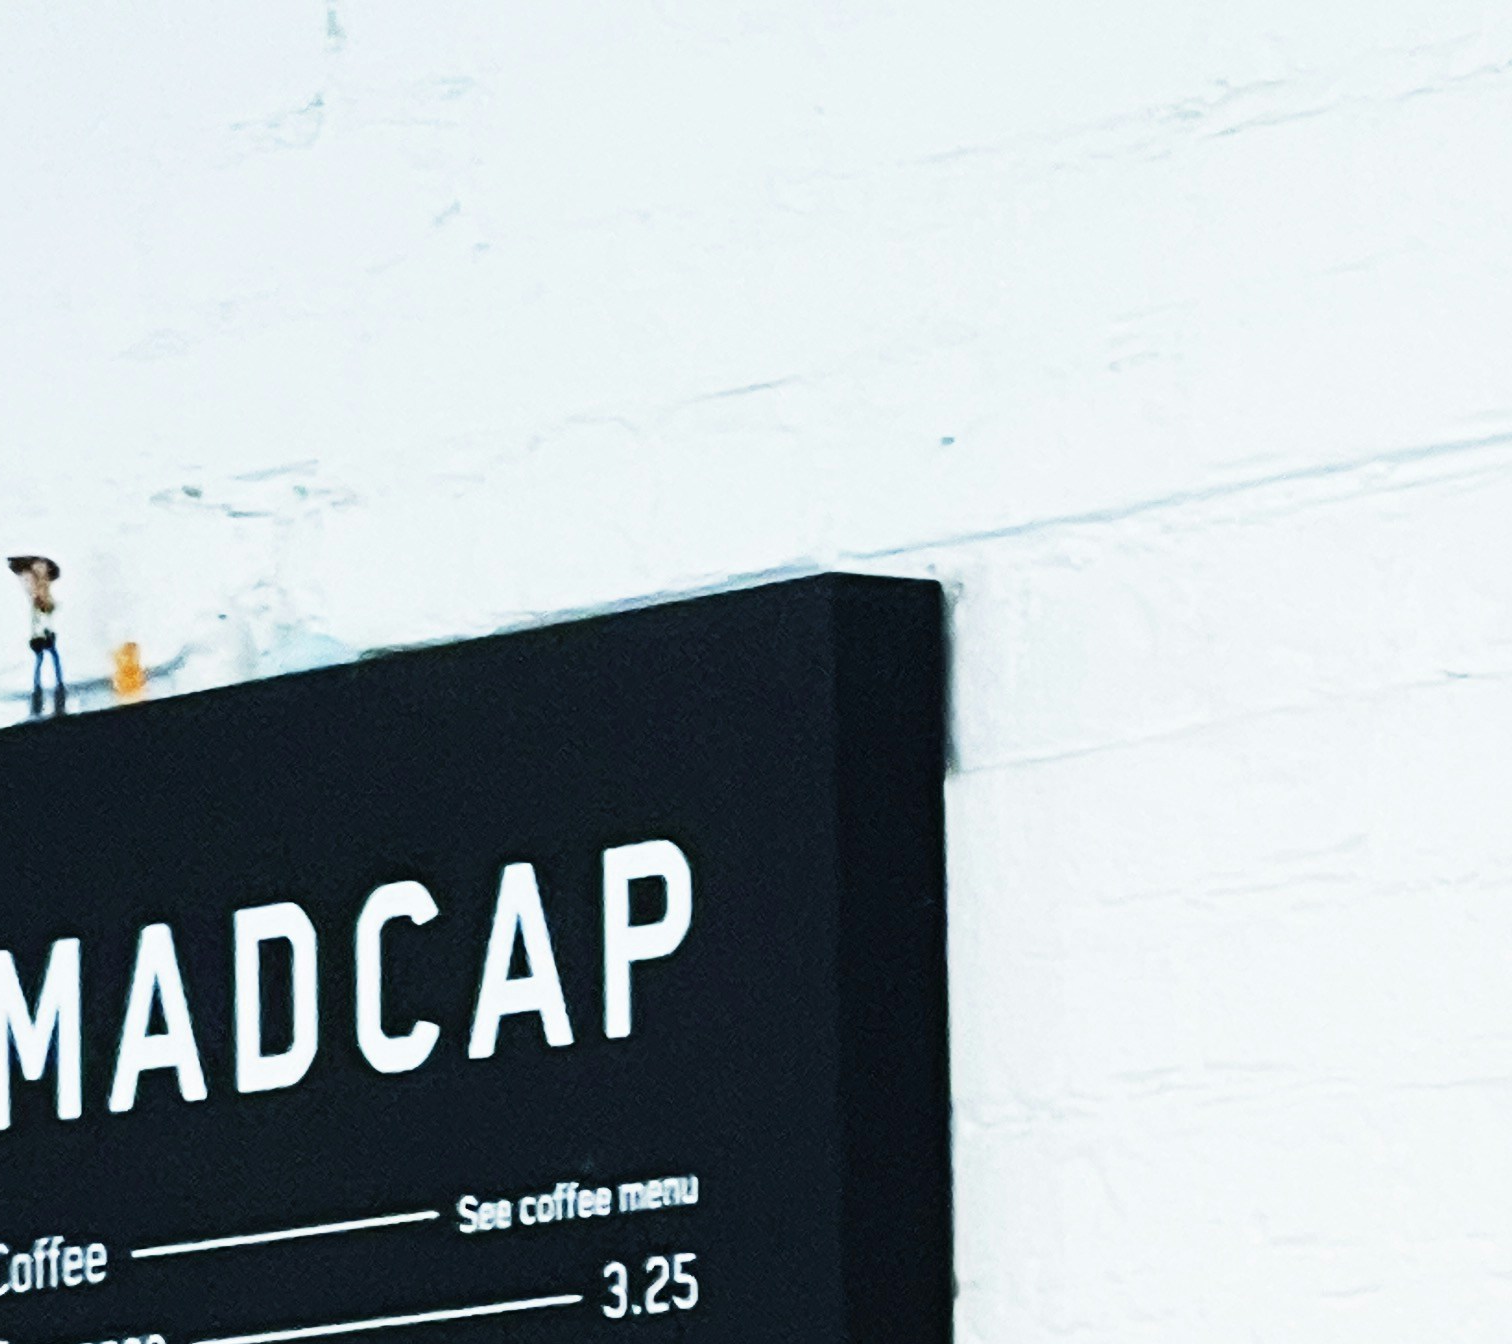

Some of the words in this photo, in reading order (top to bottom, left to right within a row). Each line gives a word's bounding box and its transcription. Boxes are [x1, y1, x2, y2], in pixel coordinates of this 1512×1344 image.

[457, 1195, 512, 1234] See
[520, 1182, 613, 1225] coffee
[618, 1175, 699, 1213] menu
[602, 1252, 699, 1318] 3.25
